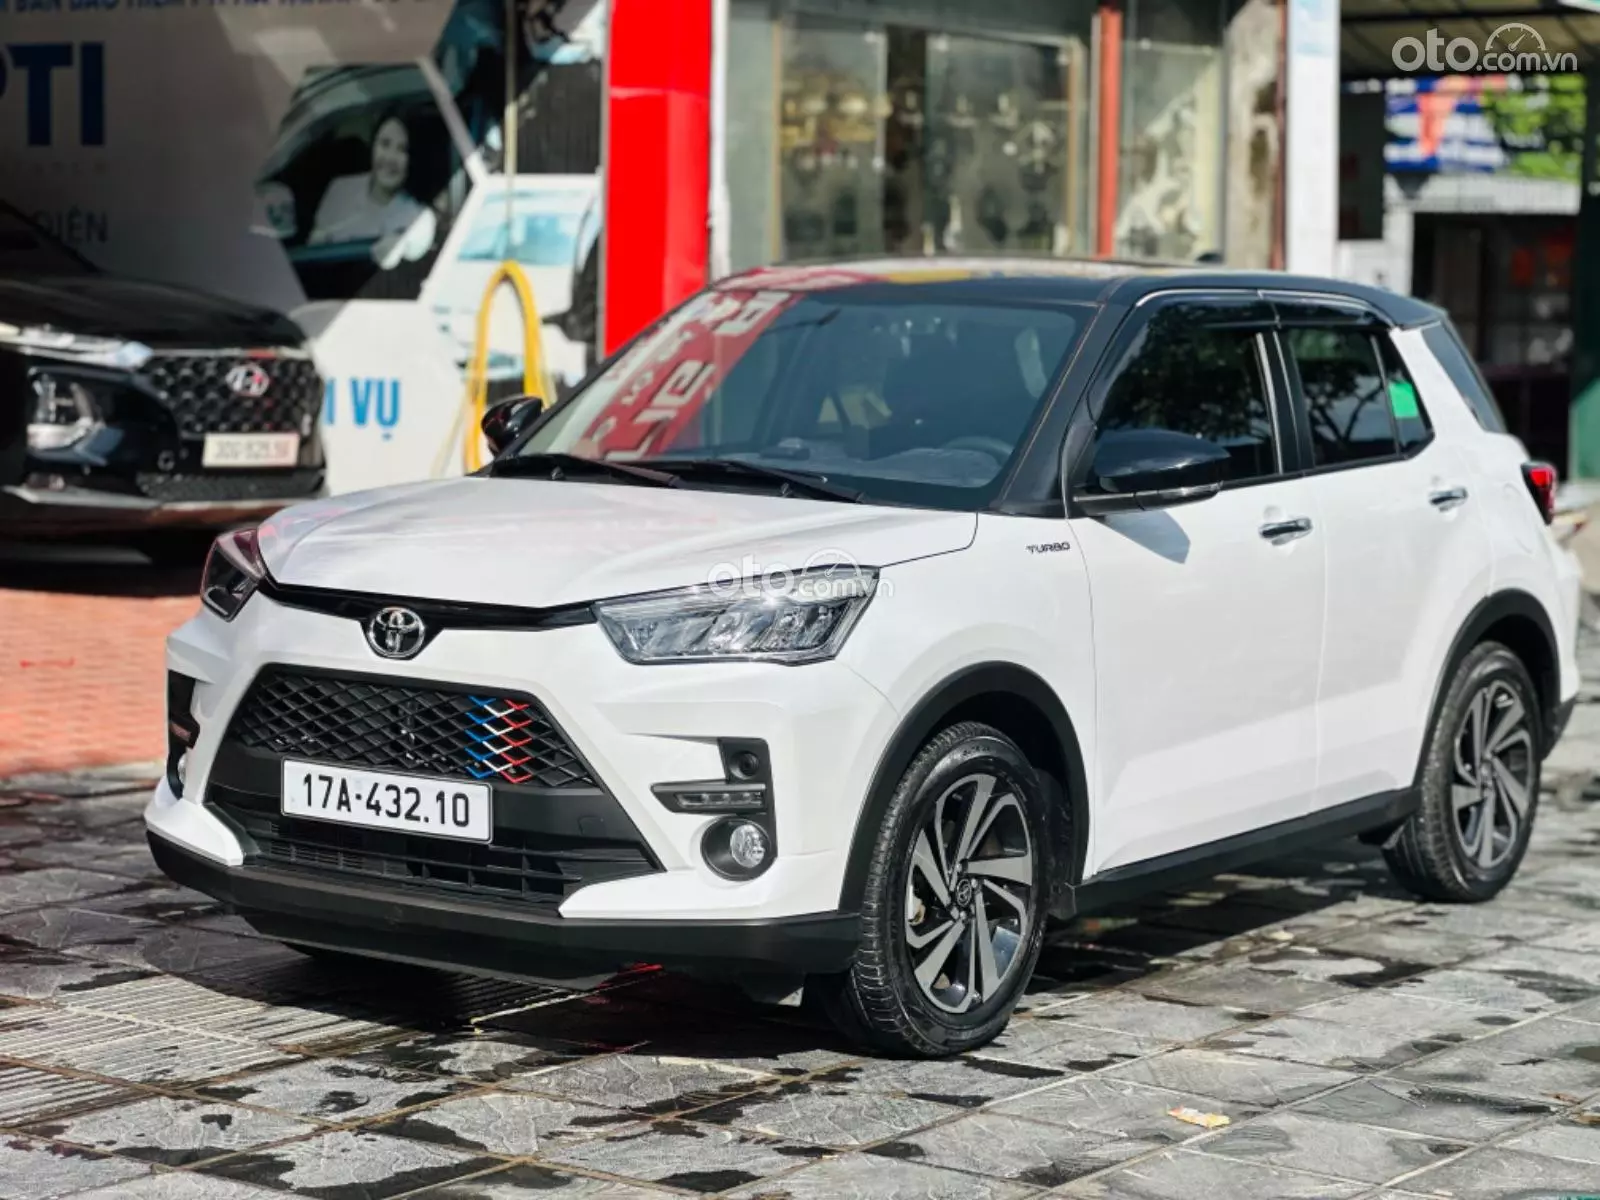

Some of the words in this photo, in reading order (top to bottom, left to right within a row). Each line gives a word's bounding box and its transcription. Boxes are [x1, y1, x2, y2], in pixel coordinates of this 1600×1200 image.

[0, 41, 105, 147] TI
[349, 377, 400, 441] VỤ
[1025, 541, 1071, 554] TURBO
[303, 773, 470, 828] 17A-432.10
